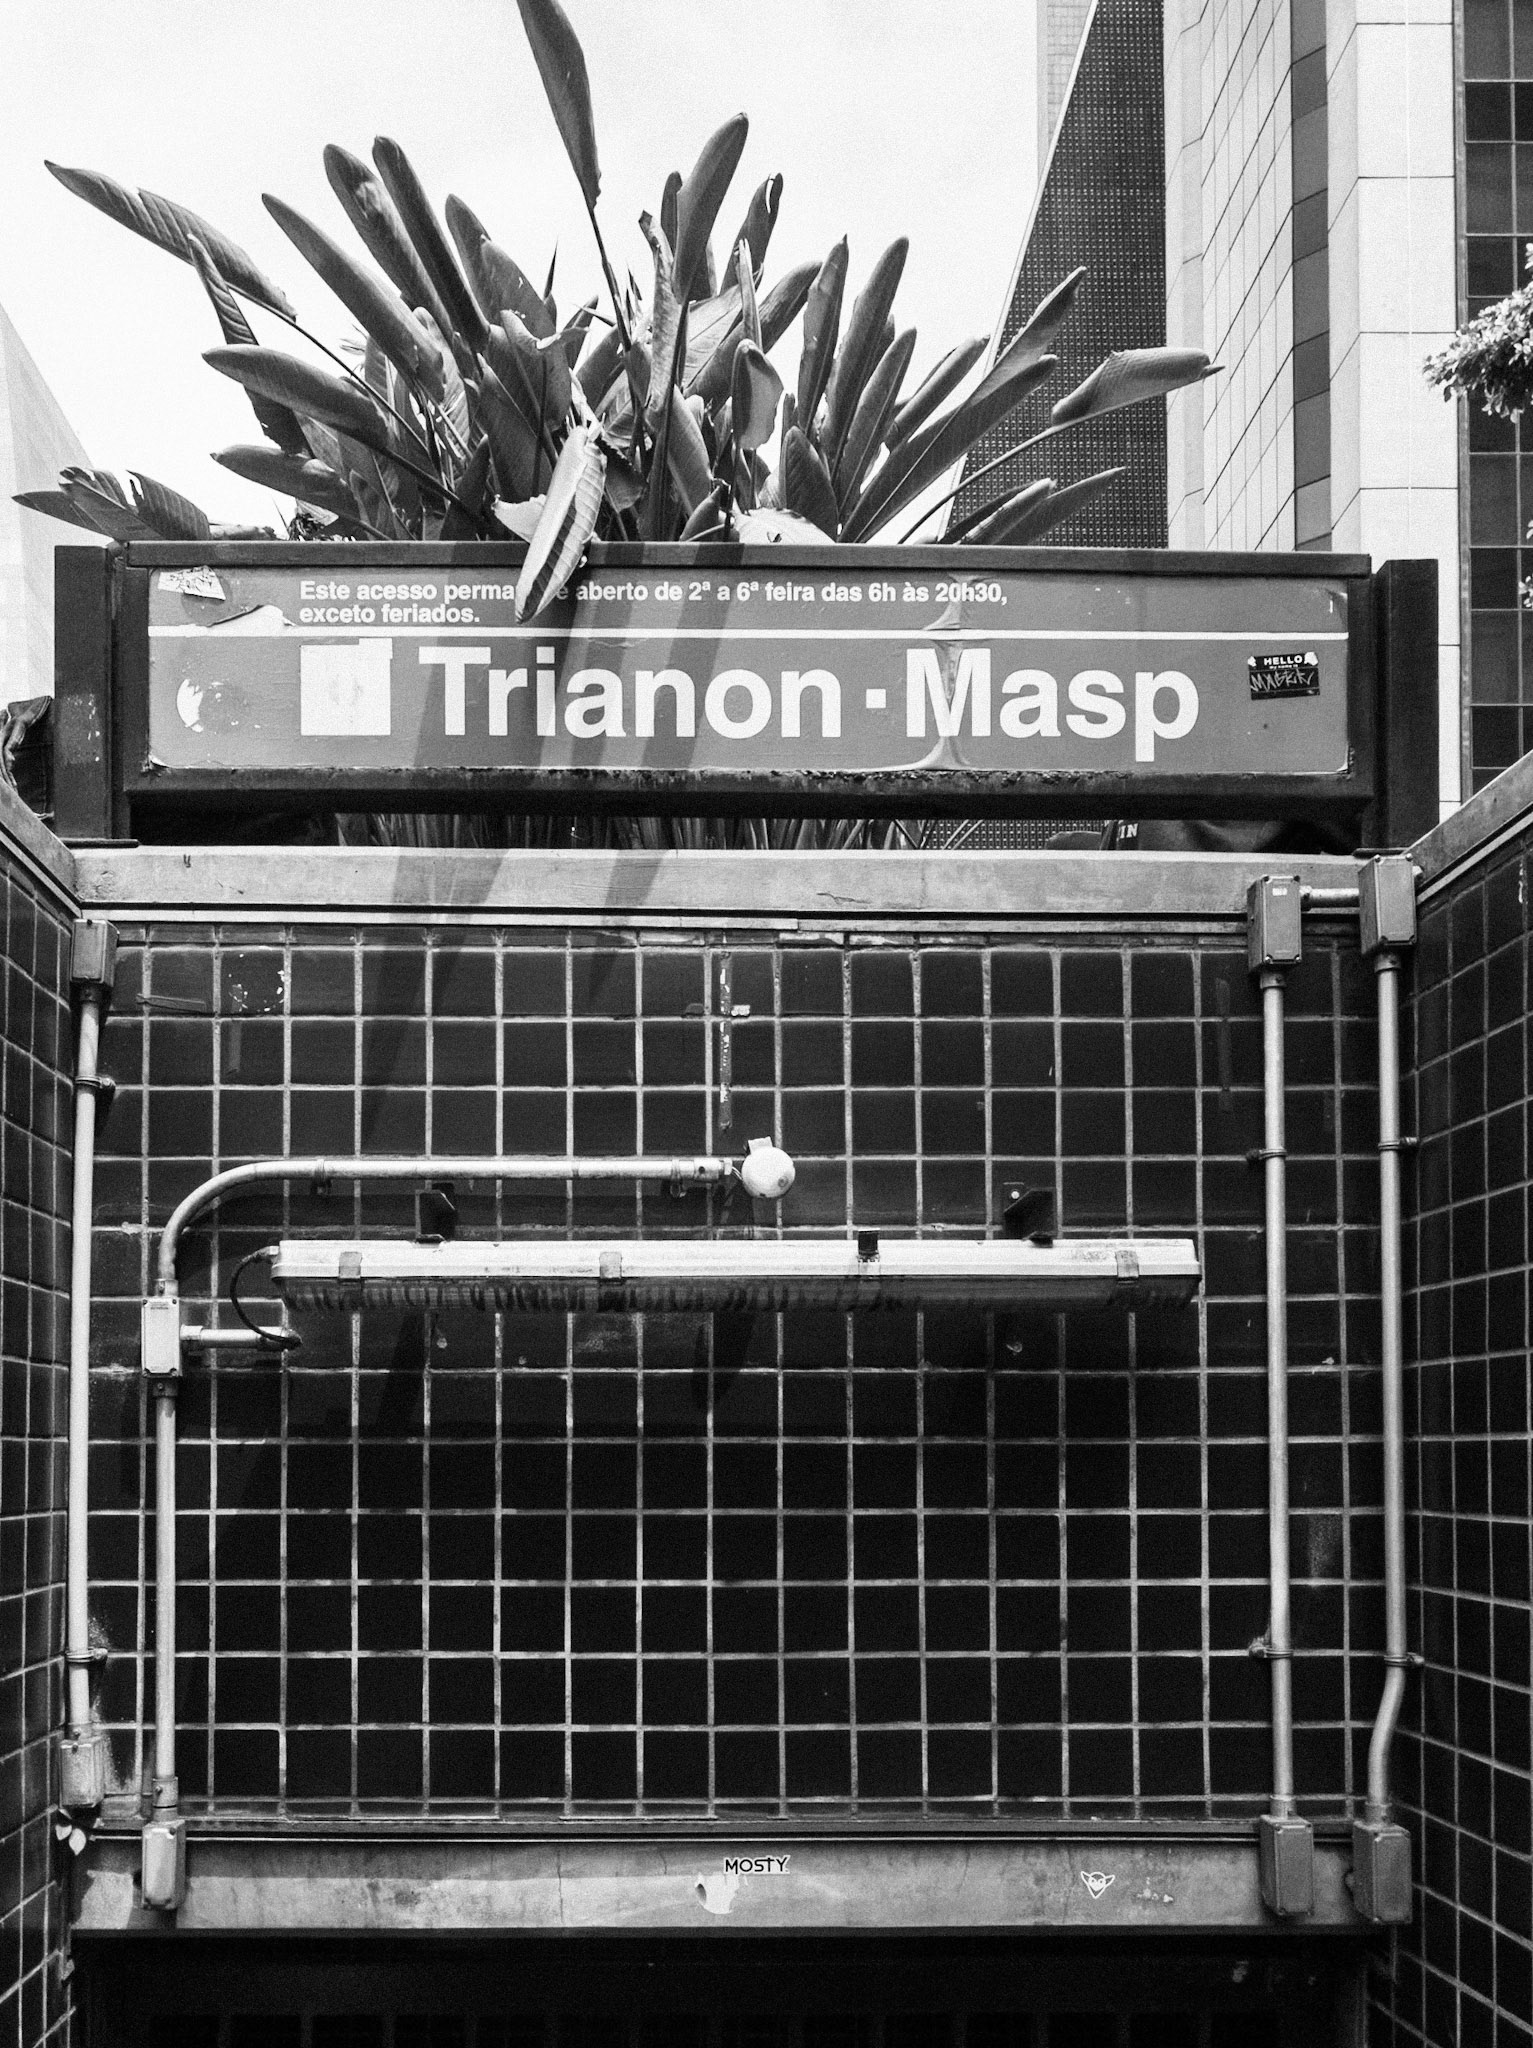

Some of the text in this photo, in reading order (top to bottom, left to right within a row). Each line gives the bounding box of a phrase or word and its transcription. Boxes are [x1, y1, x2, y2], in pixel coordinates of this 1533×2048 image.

[300, 580, 350, 600] Este
[356, 584, 437, 600] acesso
[444, 584, 569, 604] permae
[576, 581, 648, 601] aberto
[654, 581, 683, 601] de
[717, 585, 731, 601] a
[765, 581, 815, 601] feira
[821, 582, 862, 602] das
[868, 582, 897, 602] 6h
[902, 582, 929, 602] às
[935, 582, 1007, 606] 20h30,
[299, 603, 480, 623] exceto feriados.
[1263, 654, 1303, 666] HELLO
[418, 646, 842, 739] Trianon
[906, 648, 1199, 762] Masp
[725, 1857, 788, 1875] MOSTY
